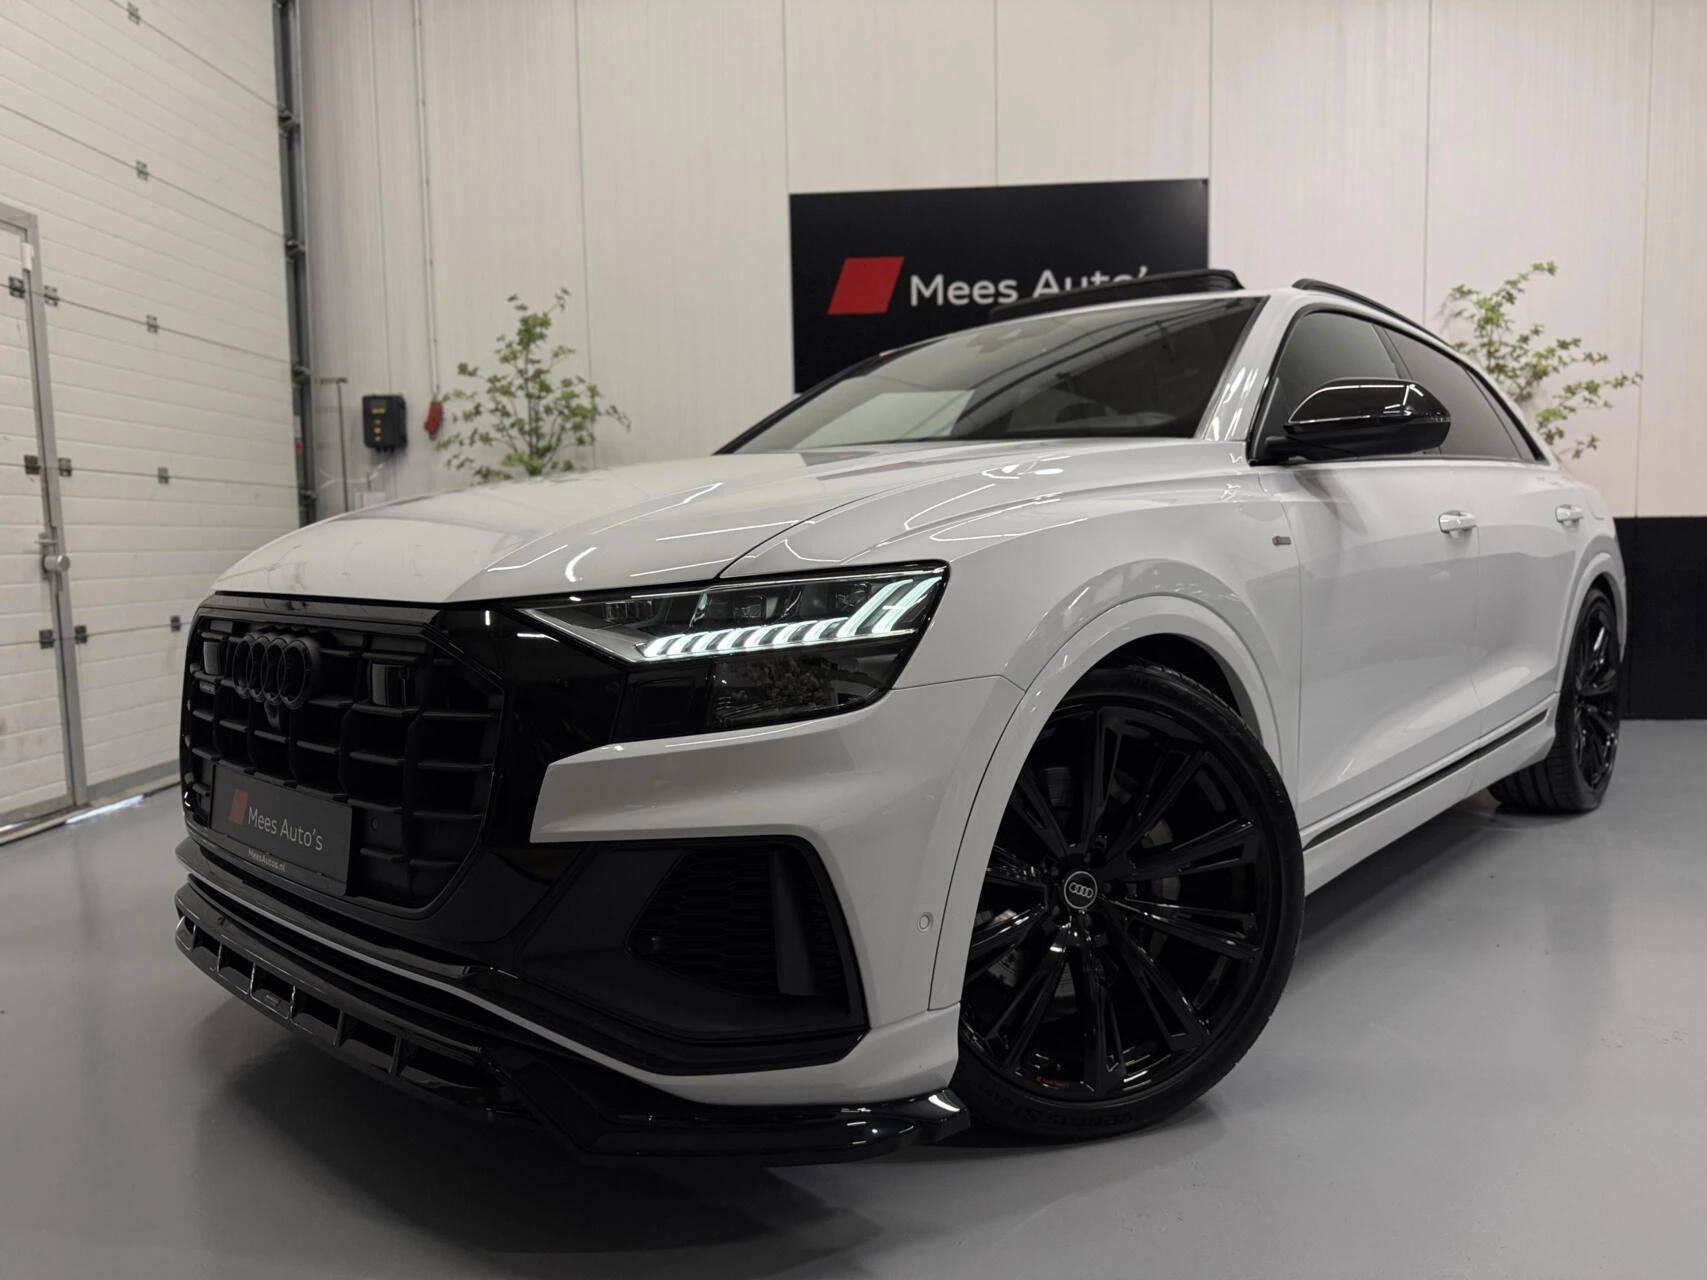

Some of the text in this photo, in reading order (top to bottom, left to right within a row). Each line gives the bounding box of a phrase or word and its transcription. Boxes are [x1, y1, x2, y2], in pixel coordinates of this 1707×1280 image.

[910, 265, 1149, 307] Mees Aut'
[247, 805, 323, 851] Mees Auto's
